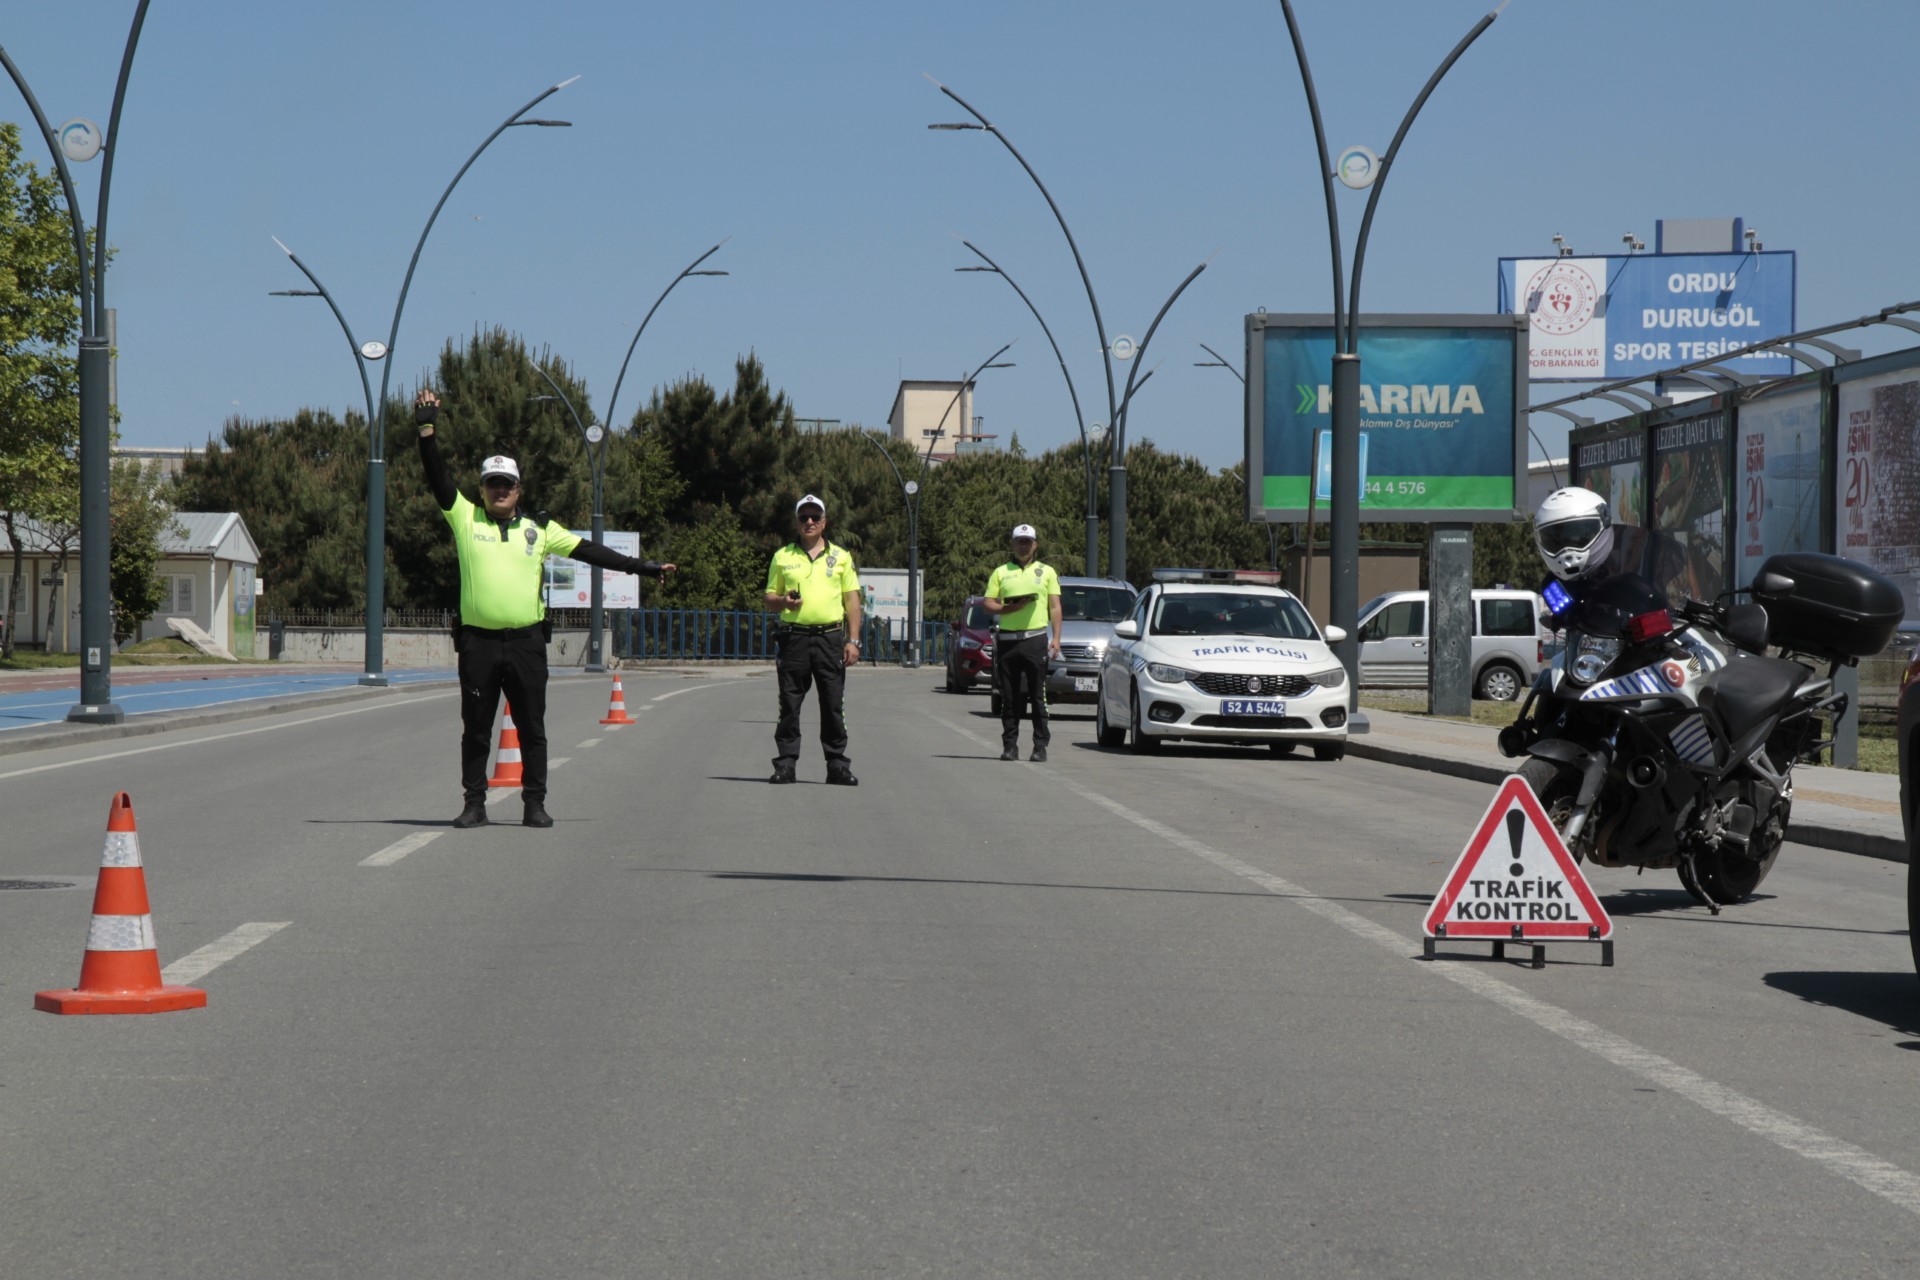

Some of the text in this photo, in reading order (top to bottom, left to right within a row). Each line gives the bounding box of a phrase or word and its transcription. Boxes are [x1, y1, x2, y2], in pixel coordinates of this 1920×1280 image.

[1668, 272, 1736, 293] ORDU
[1642, 303, 1760, 329] DURUGÖL
[1541, 347, 1583, 358] GENÇLİK
[1587, 348, 1599, 357] VE
[1613, 342, 1671, 361] SPOR
[1548, 358, 1599, 368] BAKANLIĞI
[1360, 418, 1393, 428] klamın
[1395, 418, 1411, 430] Dış
[1656, 424, 1684, 451] LEZZETE
[1686, 419, 1709, 446] DAVET
[1579, 442, 1605, 468] LEZZETE
[1607, 437, 1628, 462] DAVET
[1365, 481, 1426, 494] 44 4 576
[1845, 457, 1869, 508] 20
[1746, 475, 1764, 522] 20
[1192, 645, 1308, 660] TRAFİK POLİSİ
[1227, 701, 1284, 714] 52 A 5442
[1469, 876, 1563, 899] TRAFİK
[1456, 902, 1578, 921] KONTROL
